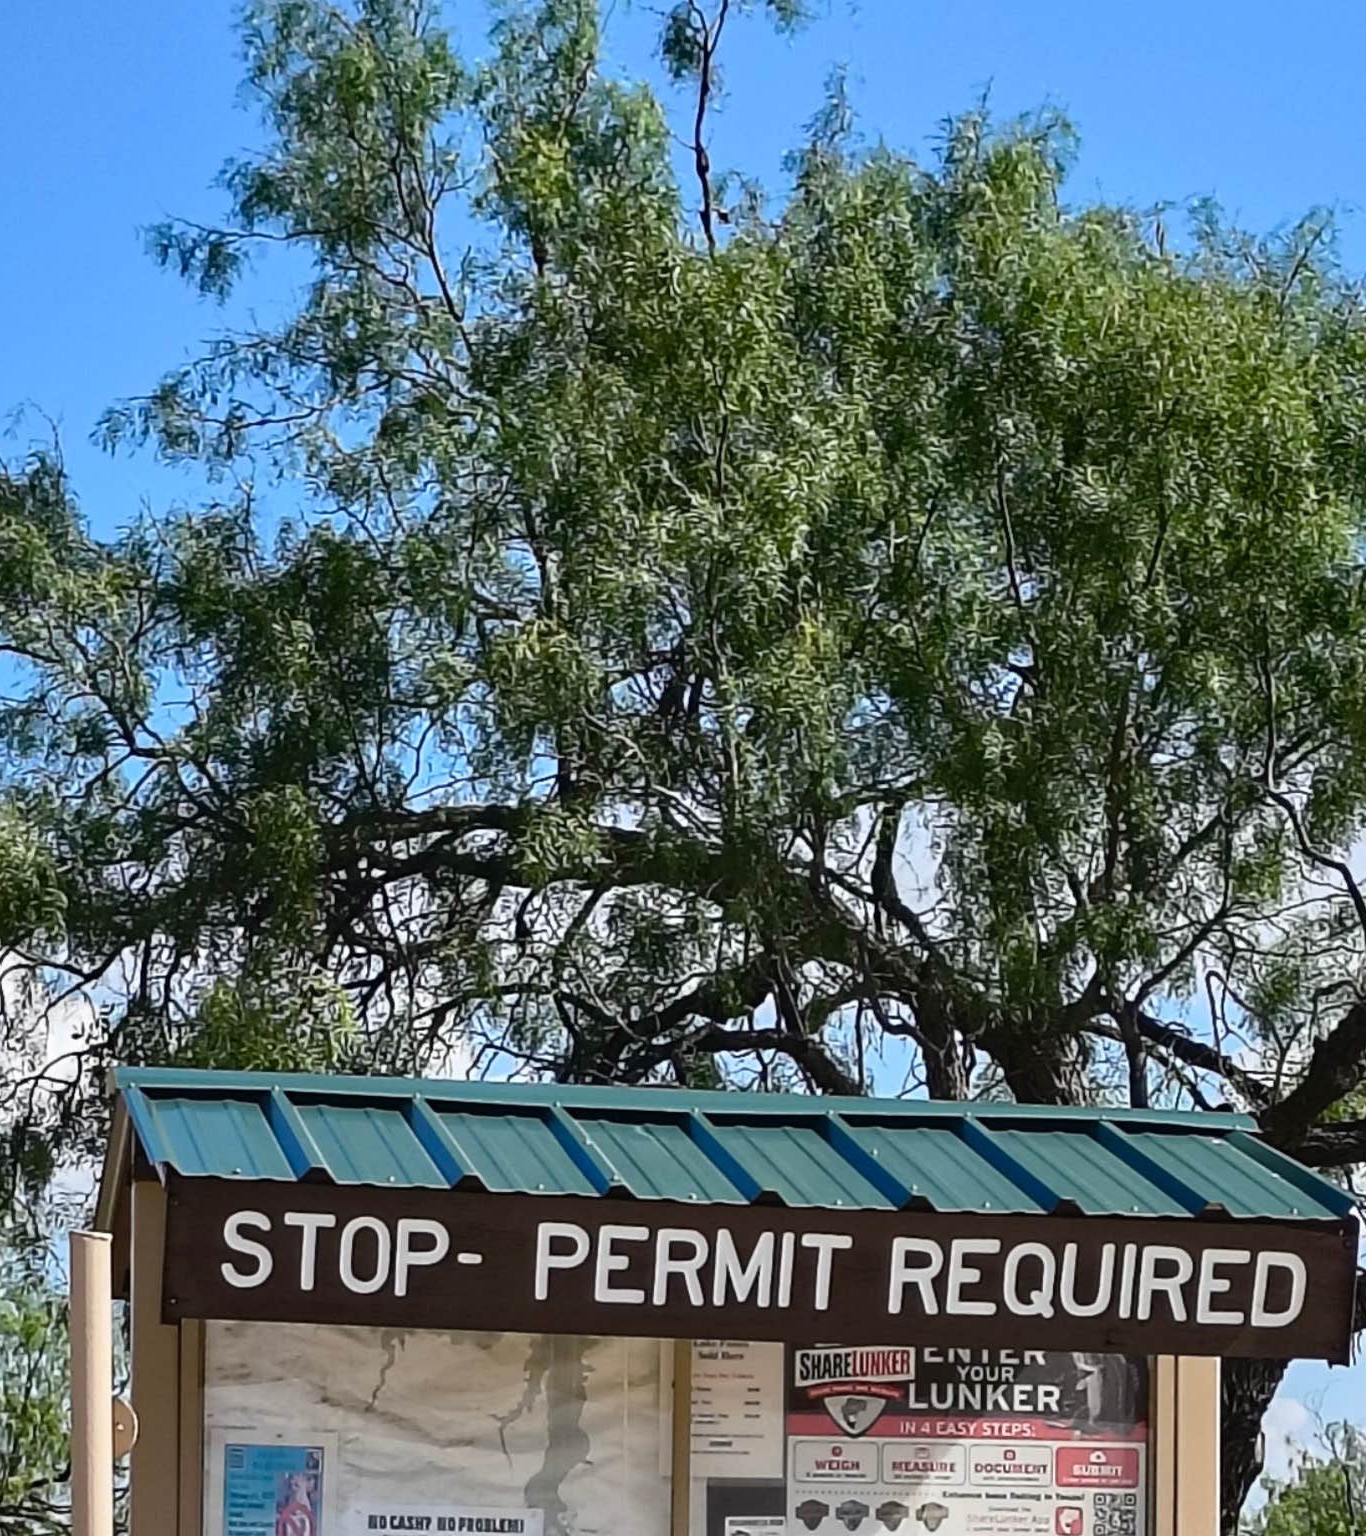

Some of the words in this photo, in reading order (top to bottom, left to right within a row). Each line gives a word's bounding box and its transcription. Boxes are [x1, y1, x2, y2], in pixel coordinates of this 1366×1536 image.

[220, 1210, 483, 1297] STOP-
[534, 1222, 852, 1311] PERMIT
[889, 1237, 1307, 1329] REQUIRED
[799, 1349, 910, 1381] SHARELUNKER
[923, 1347, 1046, 1366] ENTER
[957, 1365, 1015, 1383] YOUR
[908, 1383, 1061, 1413] LUNKER
[900, 1421, 917, 1434] IN
[921, 1422, 931, 1434] 4
[936, 1422, 978, 1436] EASY
[982, 1423, 1036, 1437] STEPS:
[815, 1460, 860, 1471] WEIGH
[892, 1461, 956, 1473] MEASURE
[974, 1463, 1048, 1475] DOCUMENT
[368, 1514, 388, 1530] NO
[390, 1515, 432, 1531] CASH?
[437, 1516, 456, 1532] NO
[458, 1517, 525, 1534] PROBLEM!
